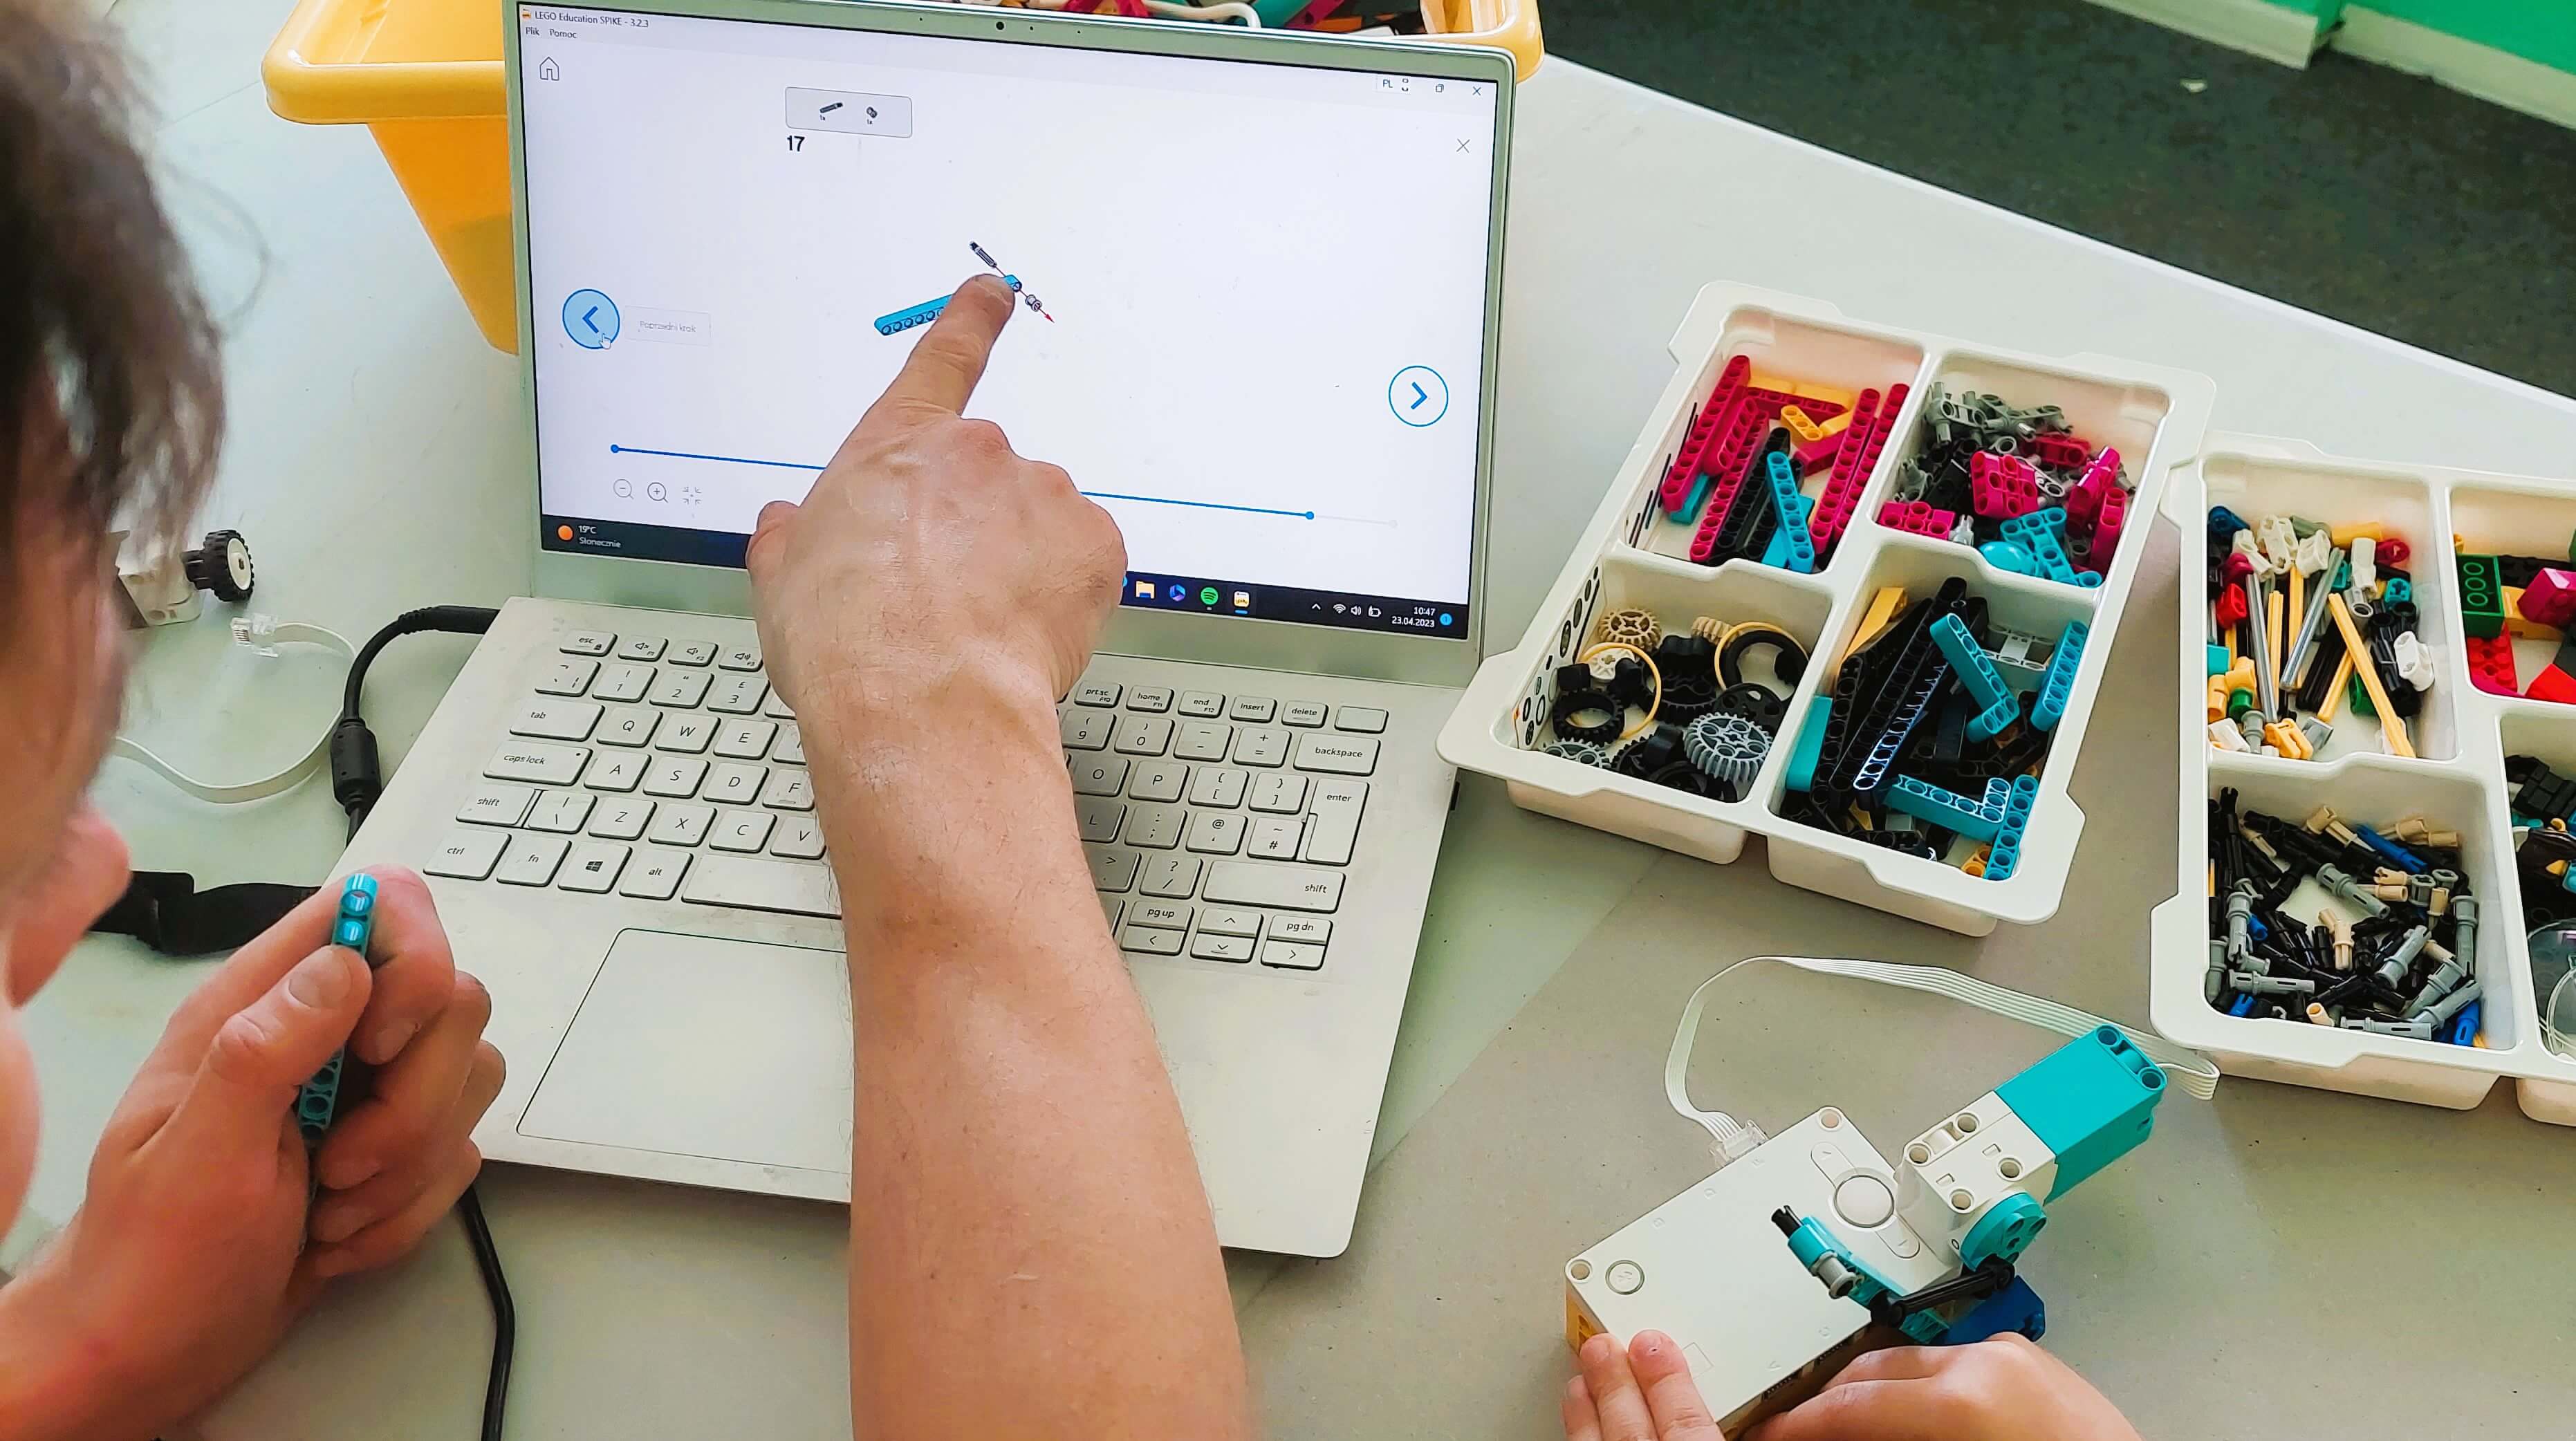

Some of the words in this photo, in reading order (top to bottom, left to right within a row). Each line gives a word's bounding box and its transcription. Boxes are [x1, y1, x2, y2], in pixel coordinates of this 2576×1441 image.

[535, 10, 557, 21] LEGO
[559, 12, 598, 24] Education
[600, 16, 622, 26] SPIKE
[630, 18, 649, 28] 3.2.3
[525, 26, 540, 36] Plik
[549, 28, 577, 39] Pomoc
[1382, 79, 1393, 89] PL
[786, 135, 806, 152] 17
[1414, 606, 1436, 616] 10:47
[1391, 615, 1436, 629] 23.04.2023
[616, 683, 623, 692] 1
[671, 689, 682, 698] 2
[728, 694, 739, 704] 3
[1137, 691, 1160, 701] home
[1240, 703, 1265, 712] insert
[1291, 707, 1317, 716] delete
[622, 720, 635, 732] Q
[680, 725, 696, 737] W
[738, 732, 751, 743] E
[1077, 730, 1087, 740] 9
[1315, 746, 1363, 758] backspace
[609, 764, 621, 775] A
[669, 770, 682, 781] S
[1152, 774, 1163, 785] P
[728, 777, 741, 788] D
[788, 783, 801, 793] F
[476, 797, 500, 807] shift
[614, 811, 628, 823] Z
[1088, 815, 1097, 826] L
[675, 817, 689, 830] X
[1212, 819, 1225, 830] @
[736, 824, 750, 836] C
[799, 830, 810, 842] V
[1268, 840, 1279, 850] #
[447, 847, 465, 855] ctrl
[528, 854, 539, 863] fn
[648, 868, 662, 876] alt
[1169, 861, 1178, 872] ?
[1304, 884, 1327, 893] shift
[1147, 909, 1161, 918] pg
[1162, 910, 1175, 919] up
[1286, 923, 1300, 932] pg
[1301, 921, 1314, 931] dn
